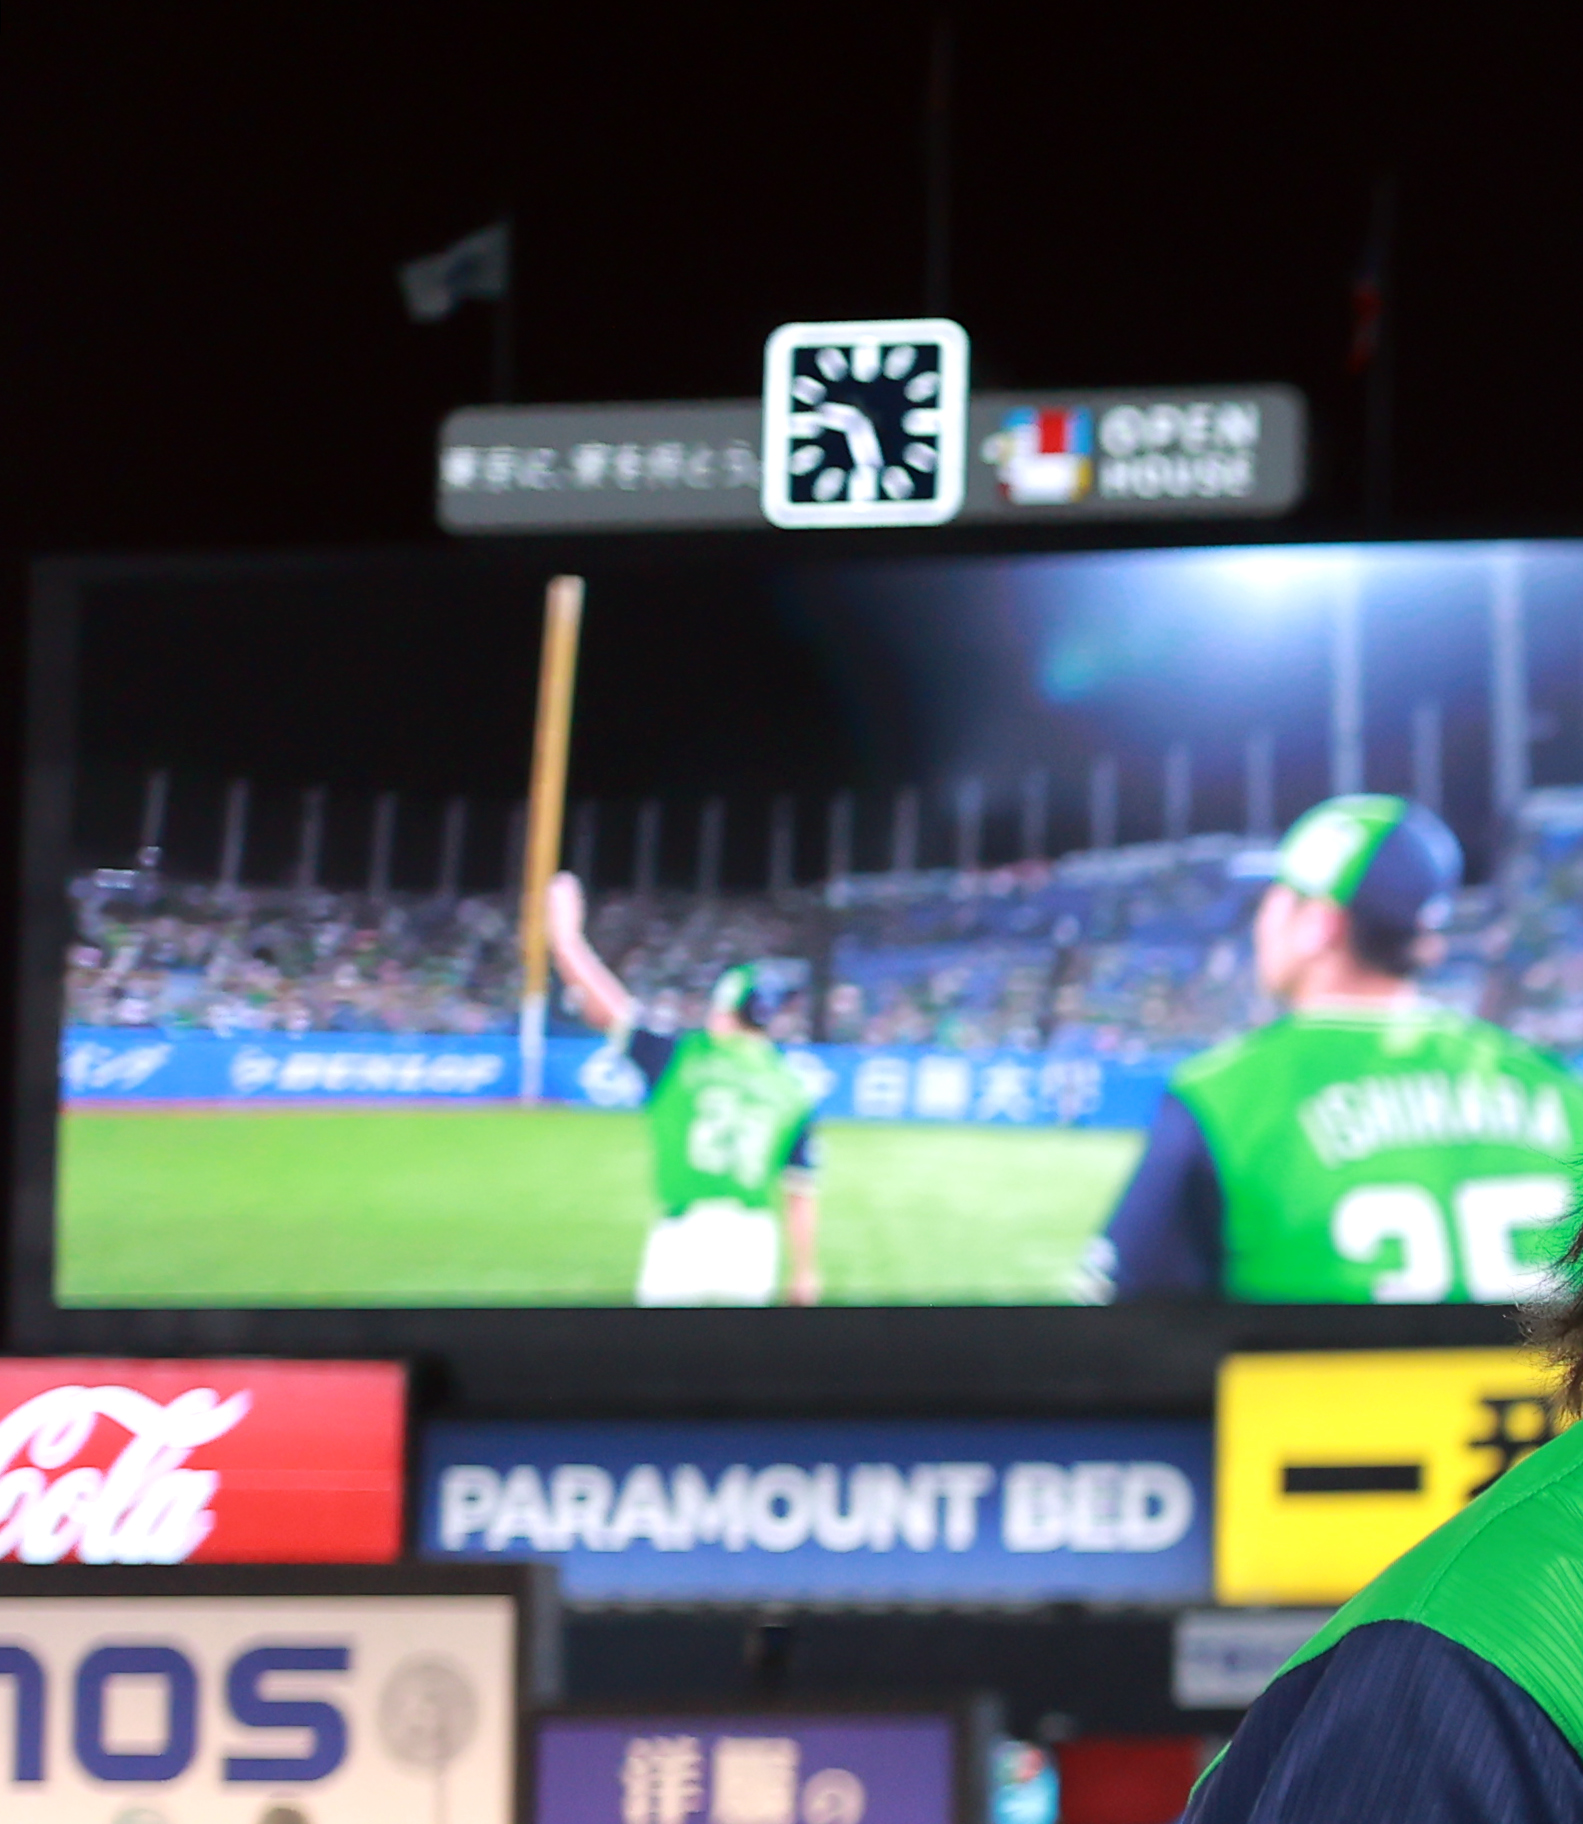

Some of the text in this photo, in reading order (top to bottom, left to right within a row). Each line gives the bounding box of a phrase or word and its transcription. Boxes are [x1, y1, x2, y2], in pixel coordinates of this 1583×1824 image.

[1101, 403, 1260, 458] OPEN
[1101, 453, 1254, 499] HOUSE
[440, 1462, 1194, 1553] PARAMOUNT BED
